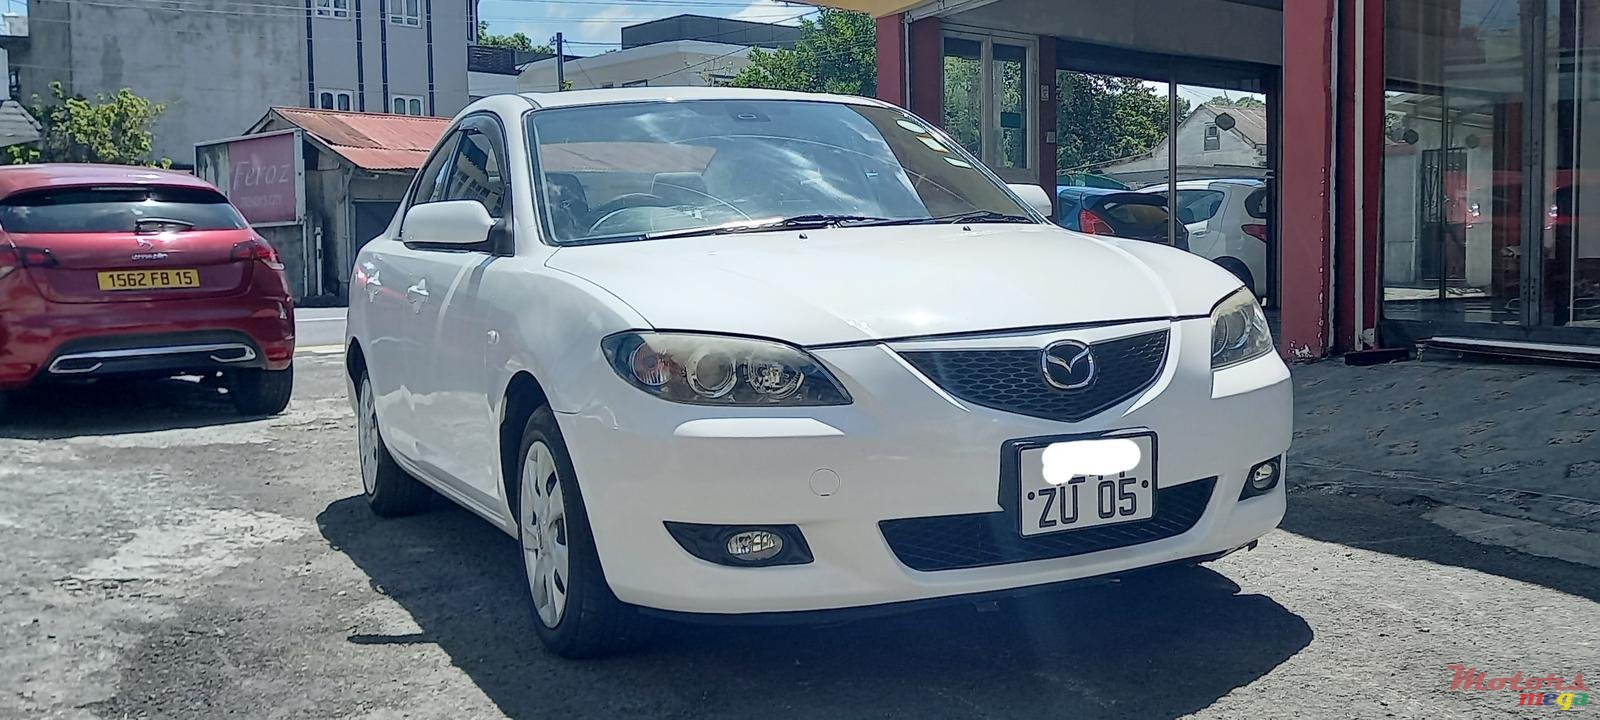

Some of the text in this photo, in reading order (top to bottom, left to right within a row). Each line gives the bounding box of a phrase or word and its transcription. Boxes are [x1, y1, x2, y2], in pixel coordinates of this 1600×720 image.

[233, 161, 290, 191] Feroz
[109, 271, 193, 287] 1562 FB 15
[1038, 477, 1137, 528] ZU 05
